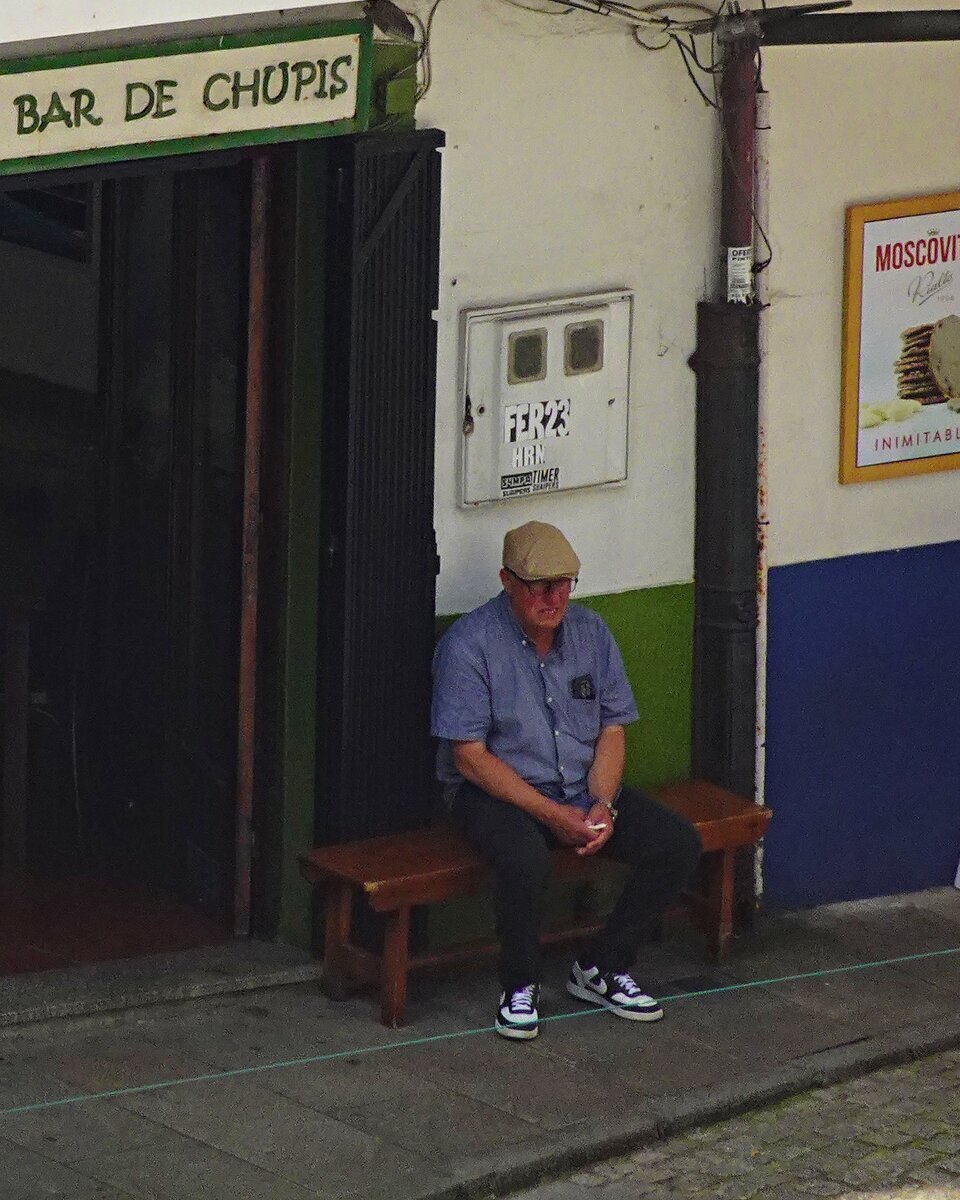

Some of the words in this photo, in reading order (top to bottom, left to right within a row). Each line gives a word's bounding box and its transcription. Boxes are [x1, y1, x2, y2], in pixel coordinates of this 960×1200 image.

[13, 88, 103, 135] BAR
[124, 80, 178, 122] DE
[203, 55, 352, 111] CHUPIS
[875, 234, 960, 272] MOSCOVI
[532, 467, 559, 484] TIMER
